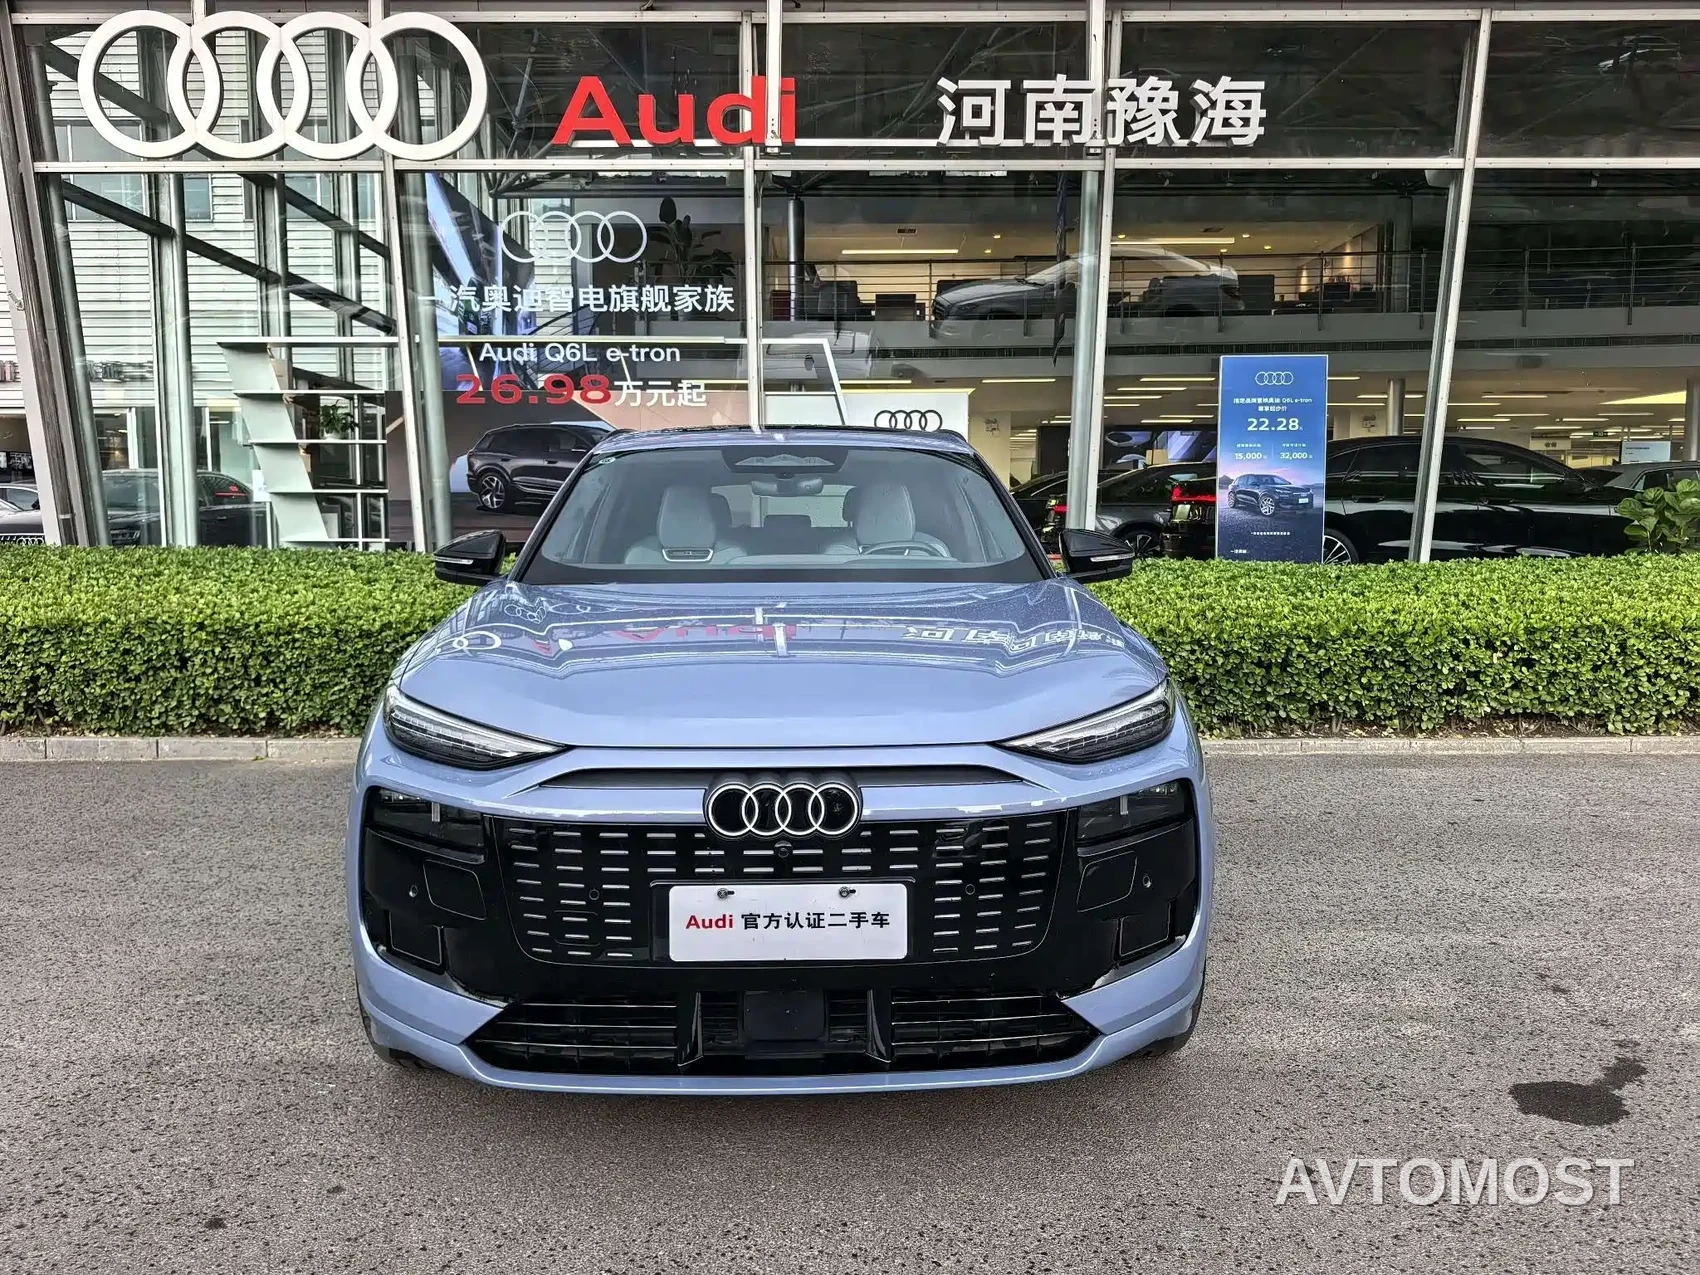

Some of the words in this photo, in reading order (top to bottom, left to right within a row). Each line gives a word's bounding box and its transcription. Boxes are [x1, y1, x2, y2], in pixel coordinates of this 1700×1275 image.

[552, 75, 796, 147] Audi
[936, 73, 1266, 147] 河南豫海
[479, 342, 537, 362] Audi
[545, 342, 597, 362] Q6L
[606, 343, 681, 362] e-tron
[686, 914, 734, 930] Audi
[741, 912, 891, 930] 官方认证二手车
